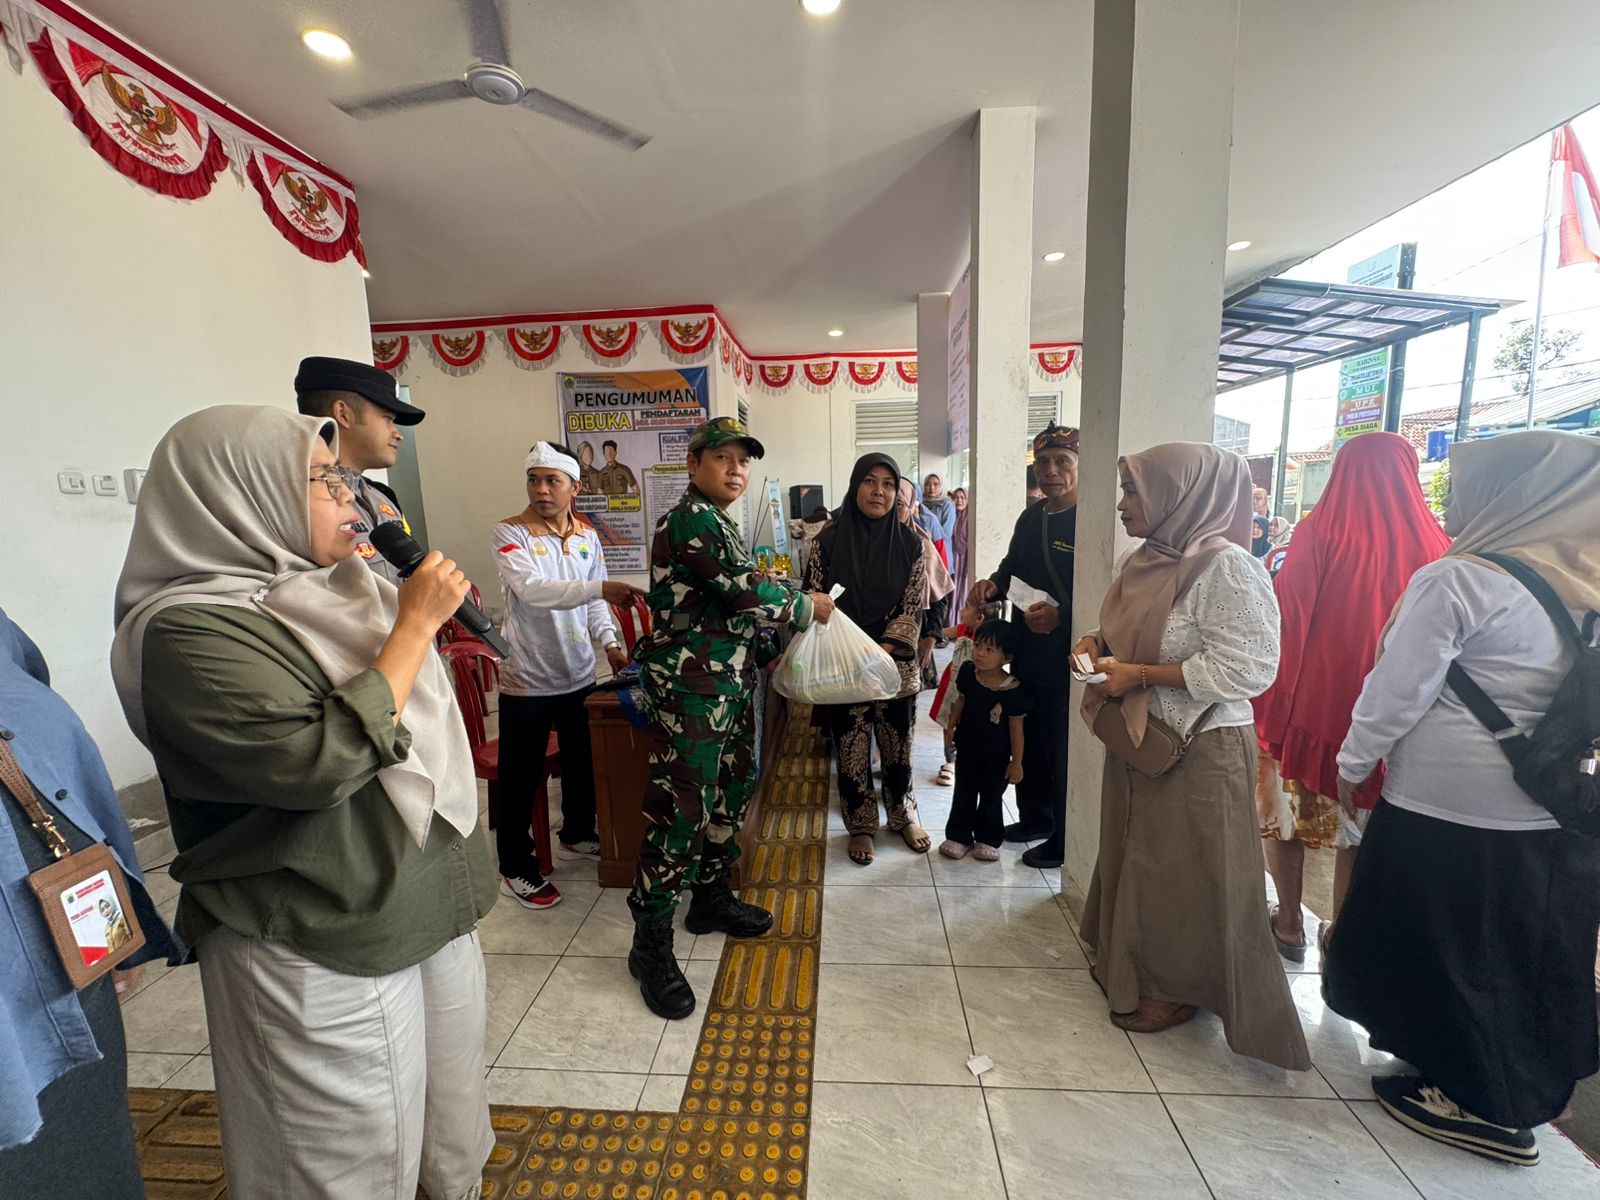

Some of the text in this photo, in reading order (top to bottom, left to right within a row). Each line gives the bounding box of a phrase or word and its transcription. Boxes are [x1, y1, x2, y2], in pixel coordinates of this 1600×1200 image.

[574, 388, 697, 407] PENGUMUMAN
[640, 408, 701, 418] PENDAFTARAN
[568, 412, 632, 432] DIBUKA
[1344, 425, 1359, 433] DESA
[1359, 422, 1378, 431] SIAGA
[662, 435, 689, 443] KUALIFIK
